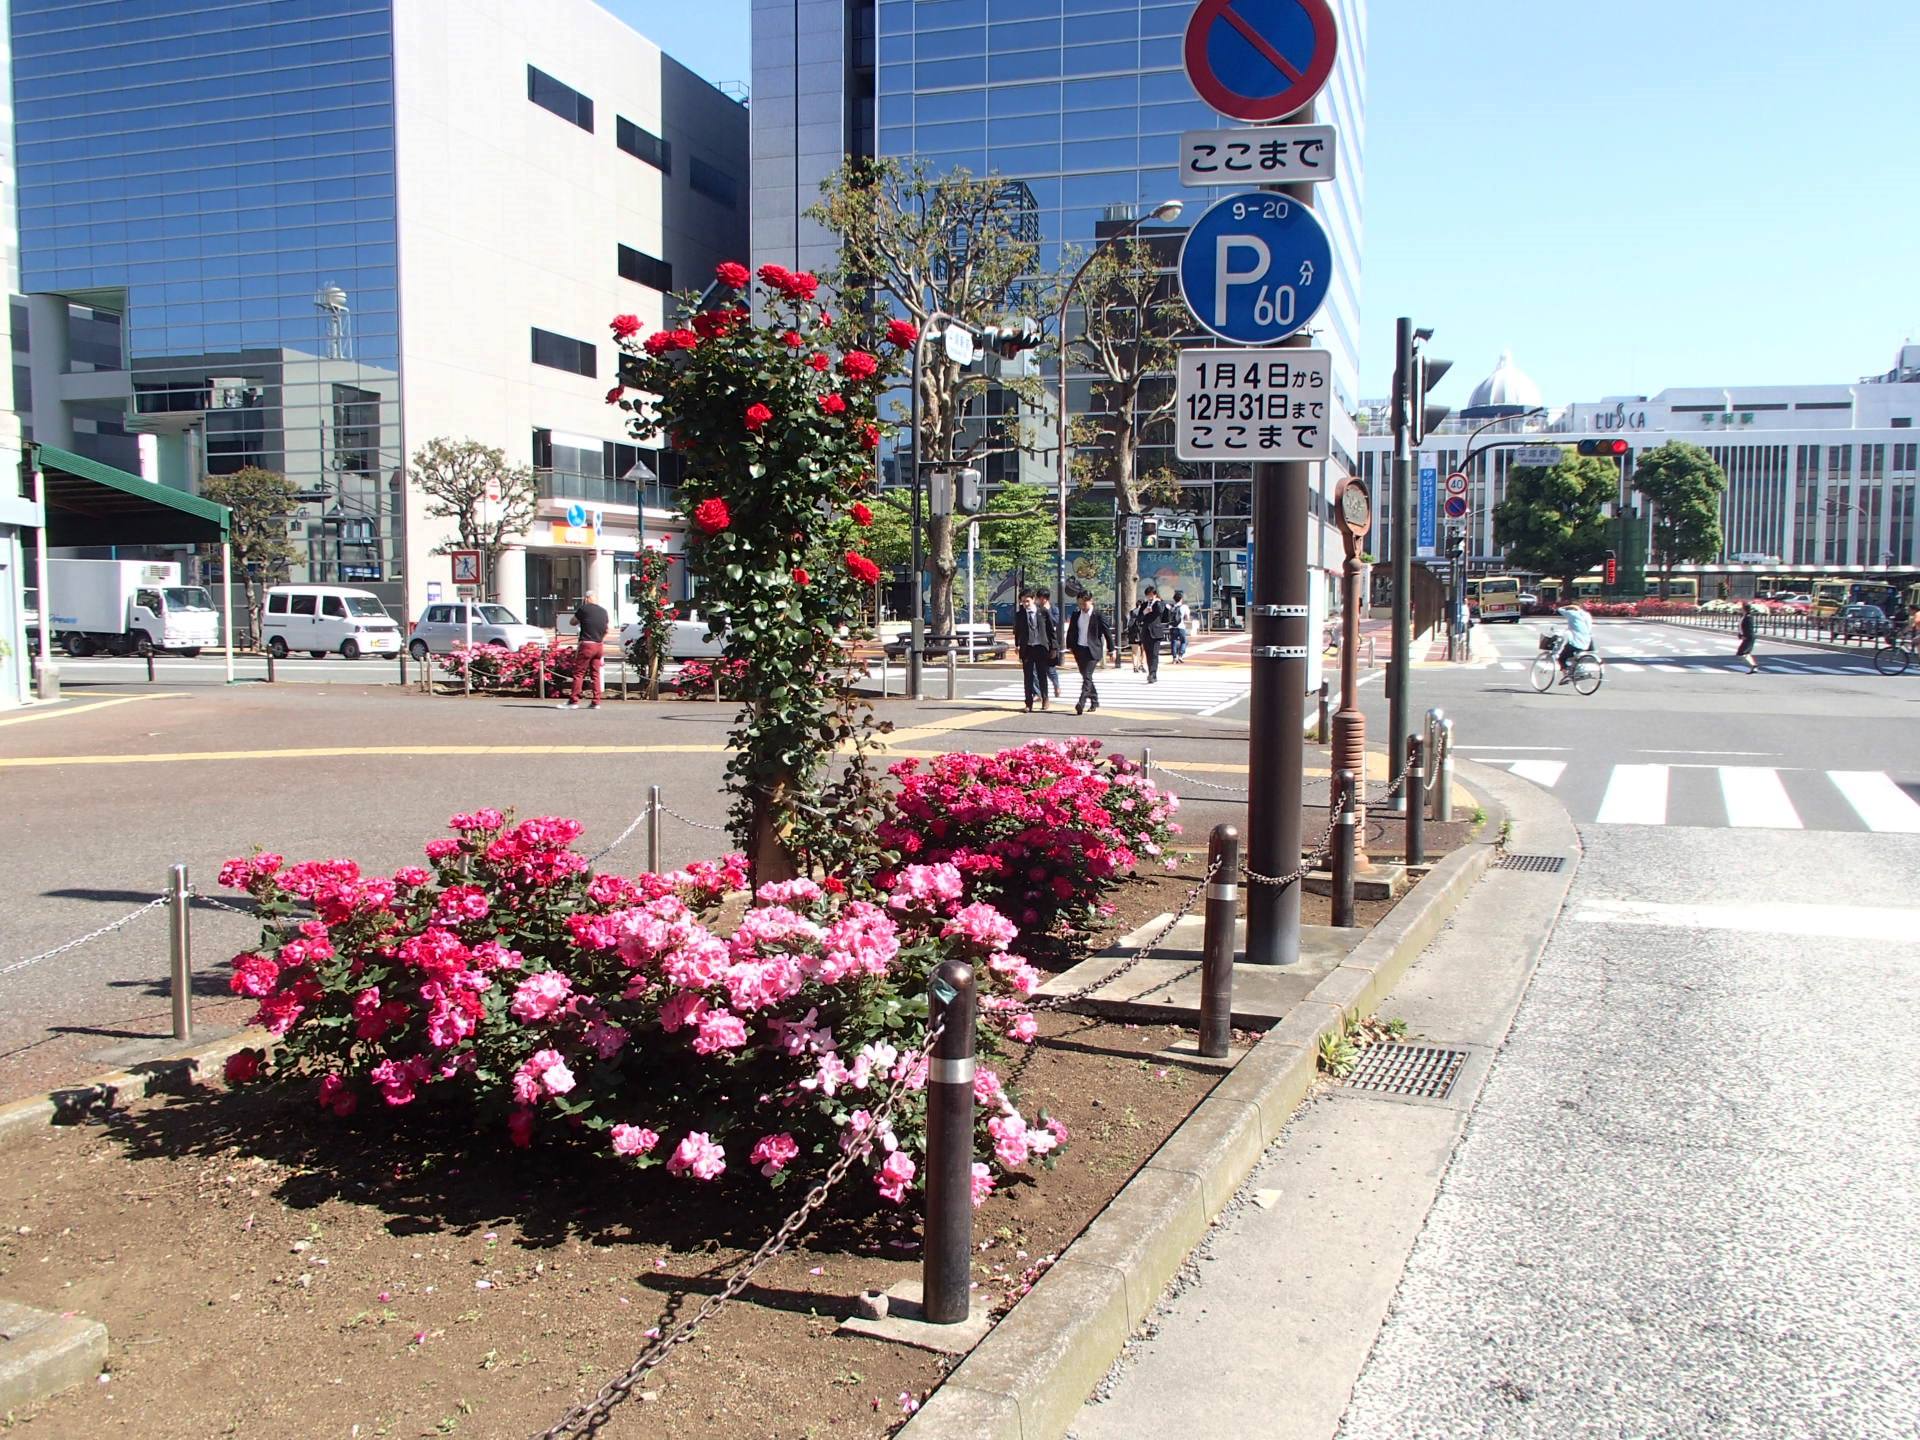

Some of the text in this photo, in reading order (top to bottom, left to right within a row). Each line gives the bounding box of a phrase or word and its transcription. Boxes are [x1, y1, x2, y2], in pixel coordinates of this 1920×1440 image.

[1190, 139, 1324, 172] ここまで
[1232, 201, 1289, 220] 9-20
[1215, 234, 1271, 327] P
[1299, 260, 1315, 286] 分
[1254, 285, 1295, 326] 60
[1196, 362, 1324, 389] 1月4日から
[1187, 393, 1324, 421] 12月31日まで
[1595, 402, 1645, 429] LUSCA
[1191, 424, 1318, 449] ここまで
[1450, 479, 1463, 489] 40
